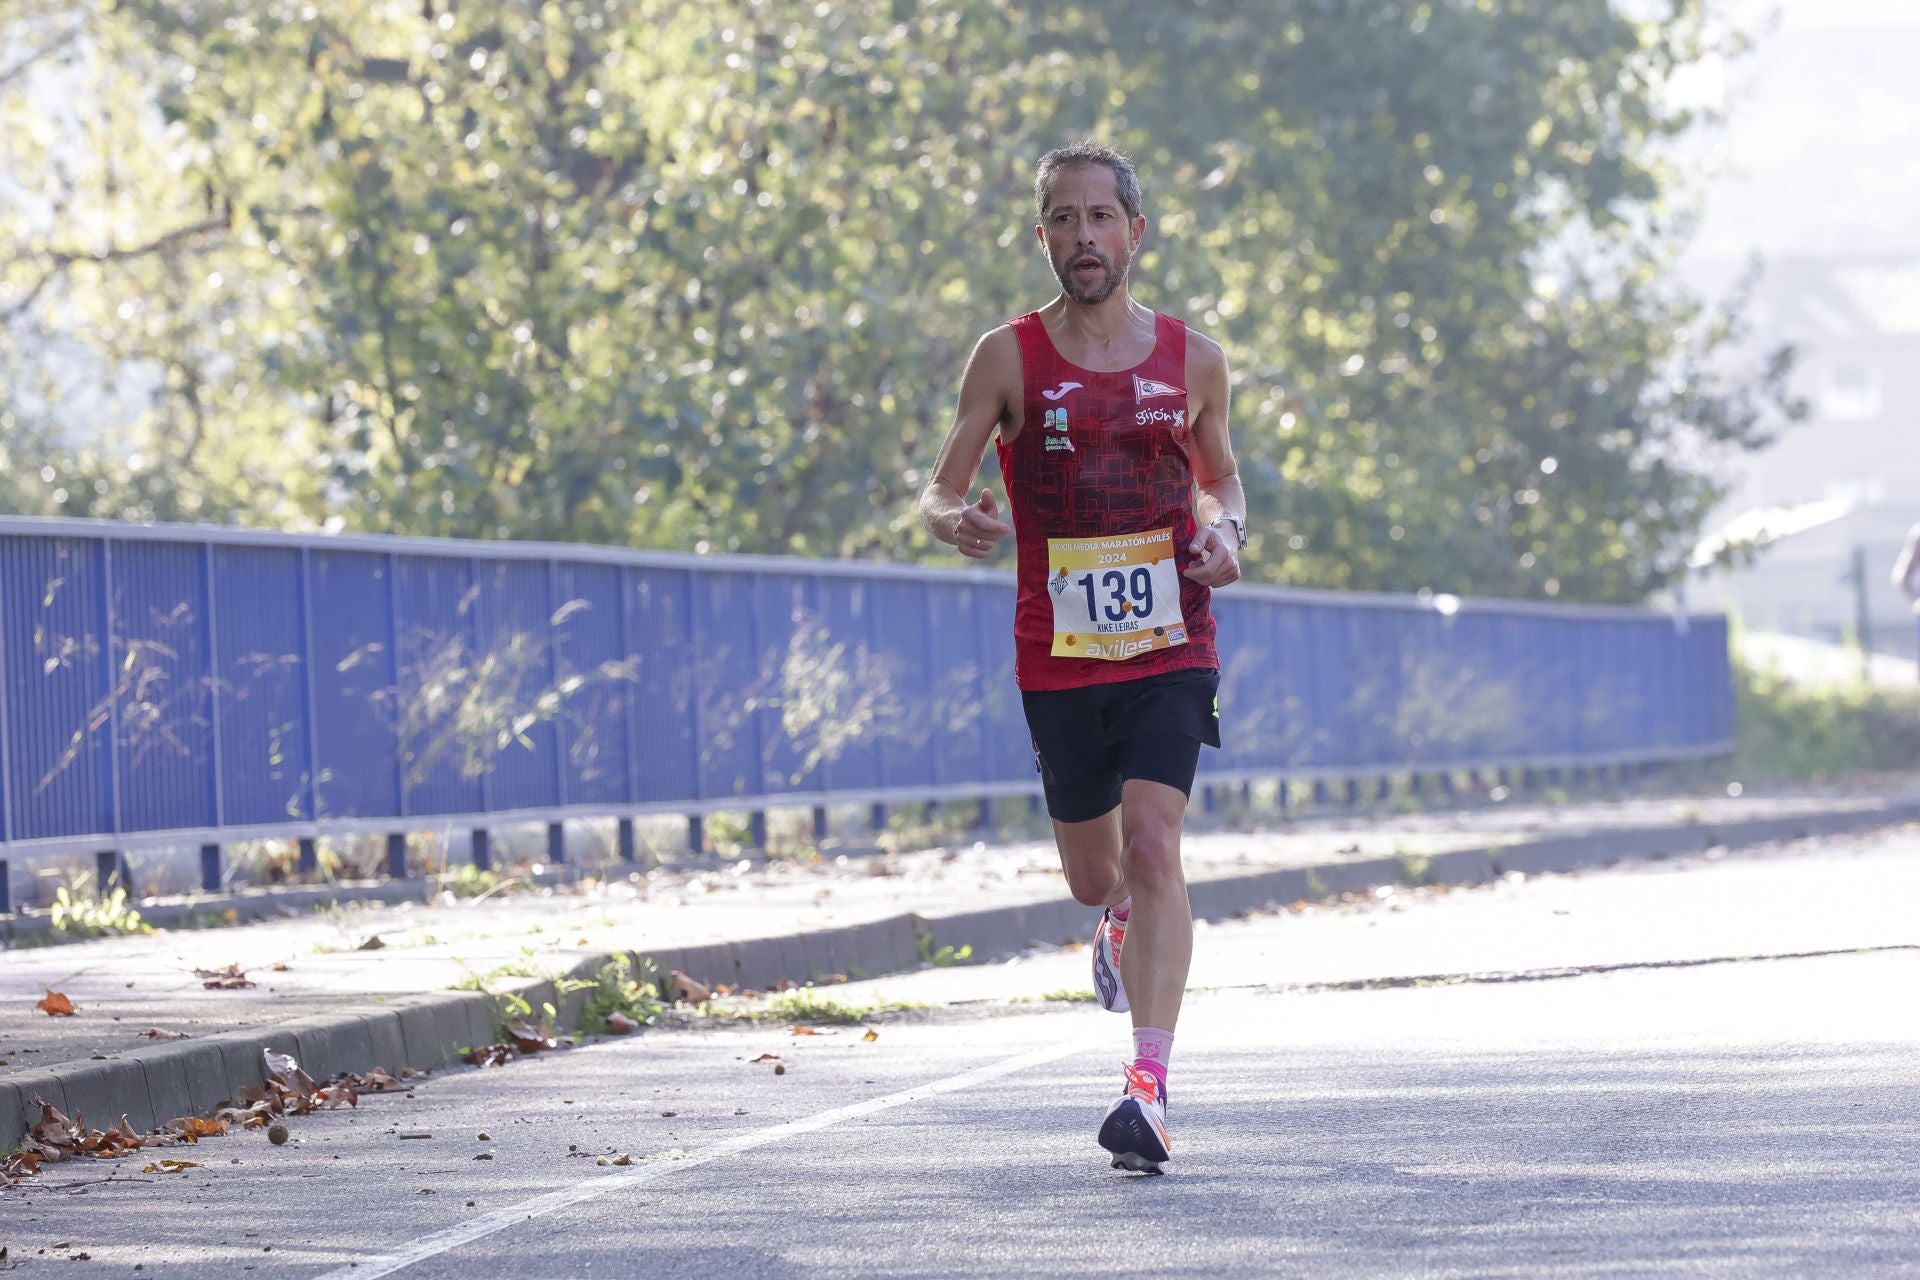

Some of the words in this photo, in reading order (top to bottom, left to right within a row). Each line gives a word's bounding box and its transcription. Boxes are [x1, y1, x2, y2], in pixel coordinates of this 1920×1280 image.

[1136, 408, 1171, 425] gijón
[1073, 542, 1100, 551] MEDIA
[1101, 538, 1145, 550] MARATÓN
[1146, 531, 1170, 544] AVILÉS
[1098, 553, 1127, 564] 2024
[1078, 567, 1153, 622] 139
[1097, 623, 1113, 633] KIKE
[1115, 621, 1139, 632] LEIRAS
